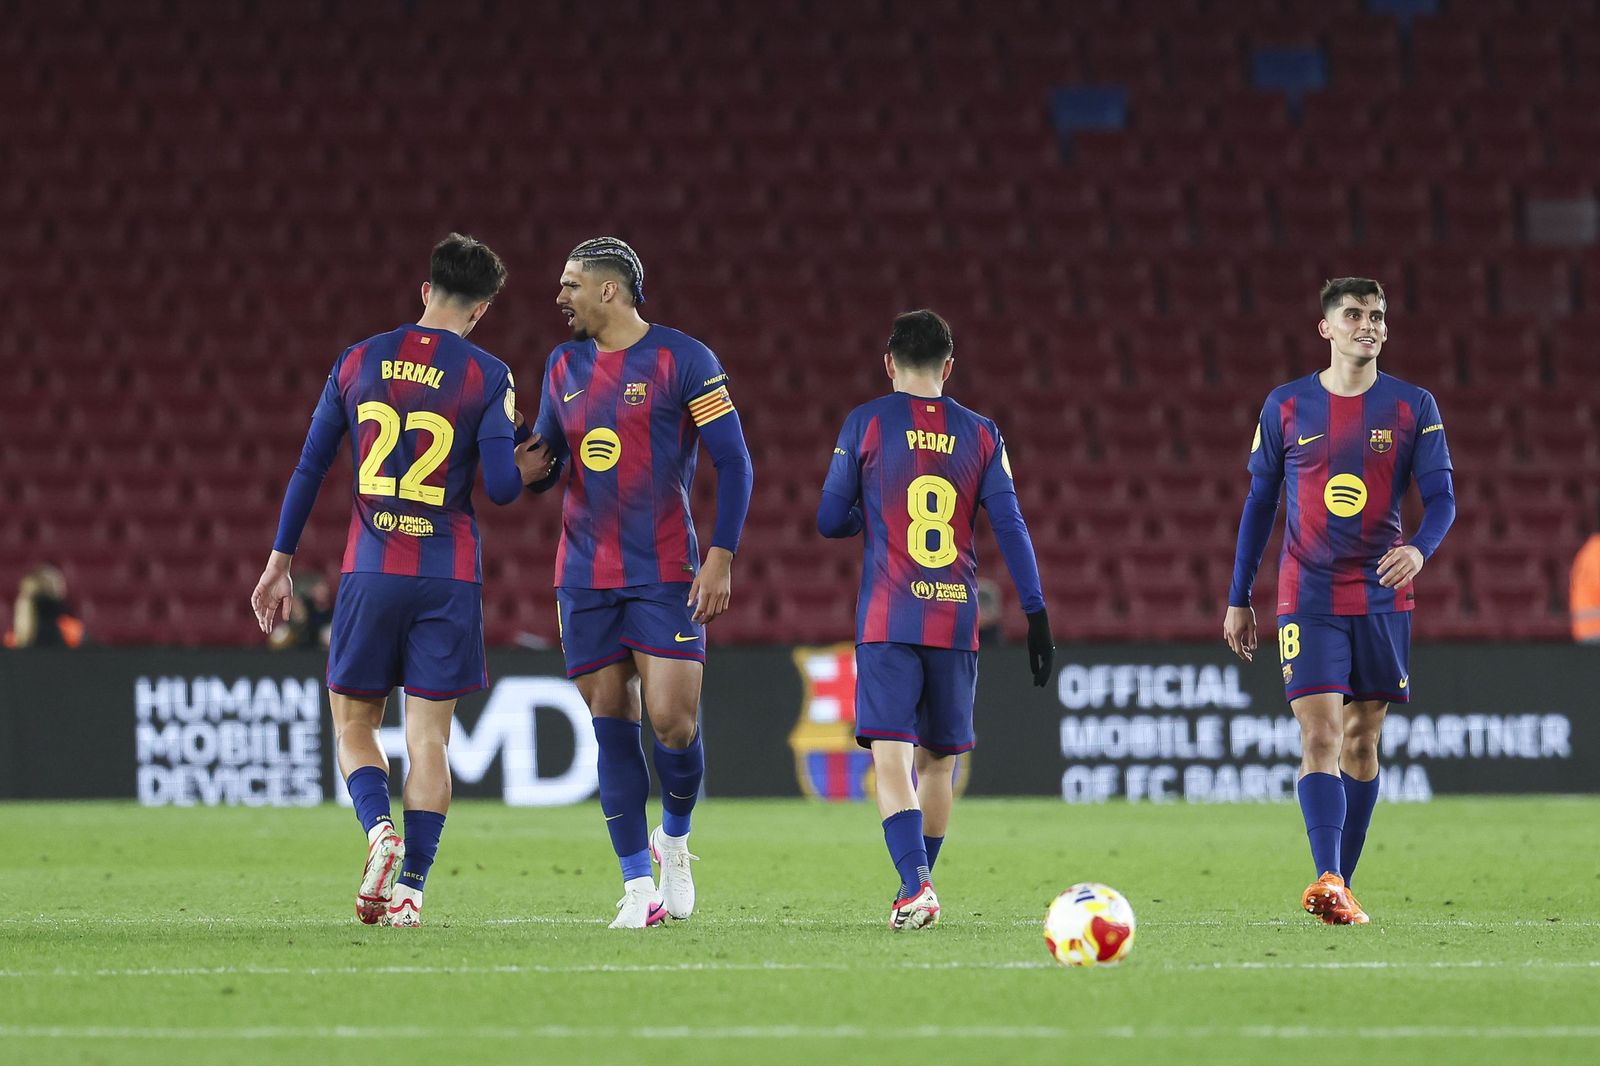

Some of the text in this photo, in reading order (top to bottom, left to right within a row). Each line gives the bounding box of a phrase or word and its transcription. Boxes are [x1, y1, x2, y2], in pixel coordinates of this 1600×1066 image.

[381, 360, 445, 389] BERNAL
[357, 401, 455, 506] 22
[906, 430, 957, 454] PEDRI
[398, 523, 434, 534] ACNUR
[907, 475, 958, 569] 8
[936, 582, 966, 592] UNHCR
[936, 590, 968, 599] ACNUR
[134, 676, 321, 722] HUMAN
[1058, 664, 1252, 709] OFFICIAL
[136, 720, 322, 766] MOBILE
[1060, 714, 1224, 759] MOBILE
[1382, 713, 1572, 758] PARTNER
[137, 764, 323, 807] DEVICES
[1062, 764, 1119, 804] OF
[1125, 764, 1178, 804] FC
